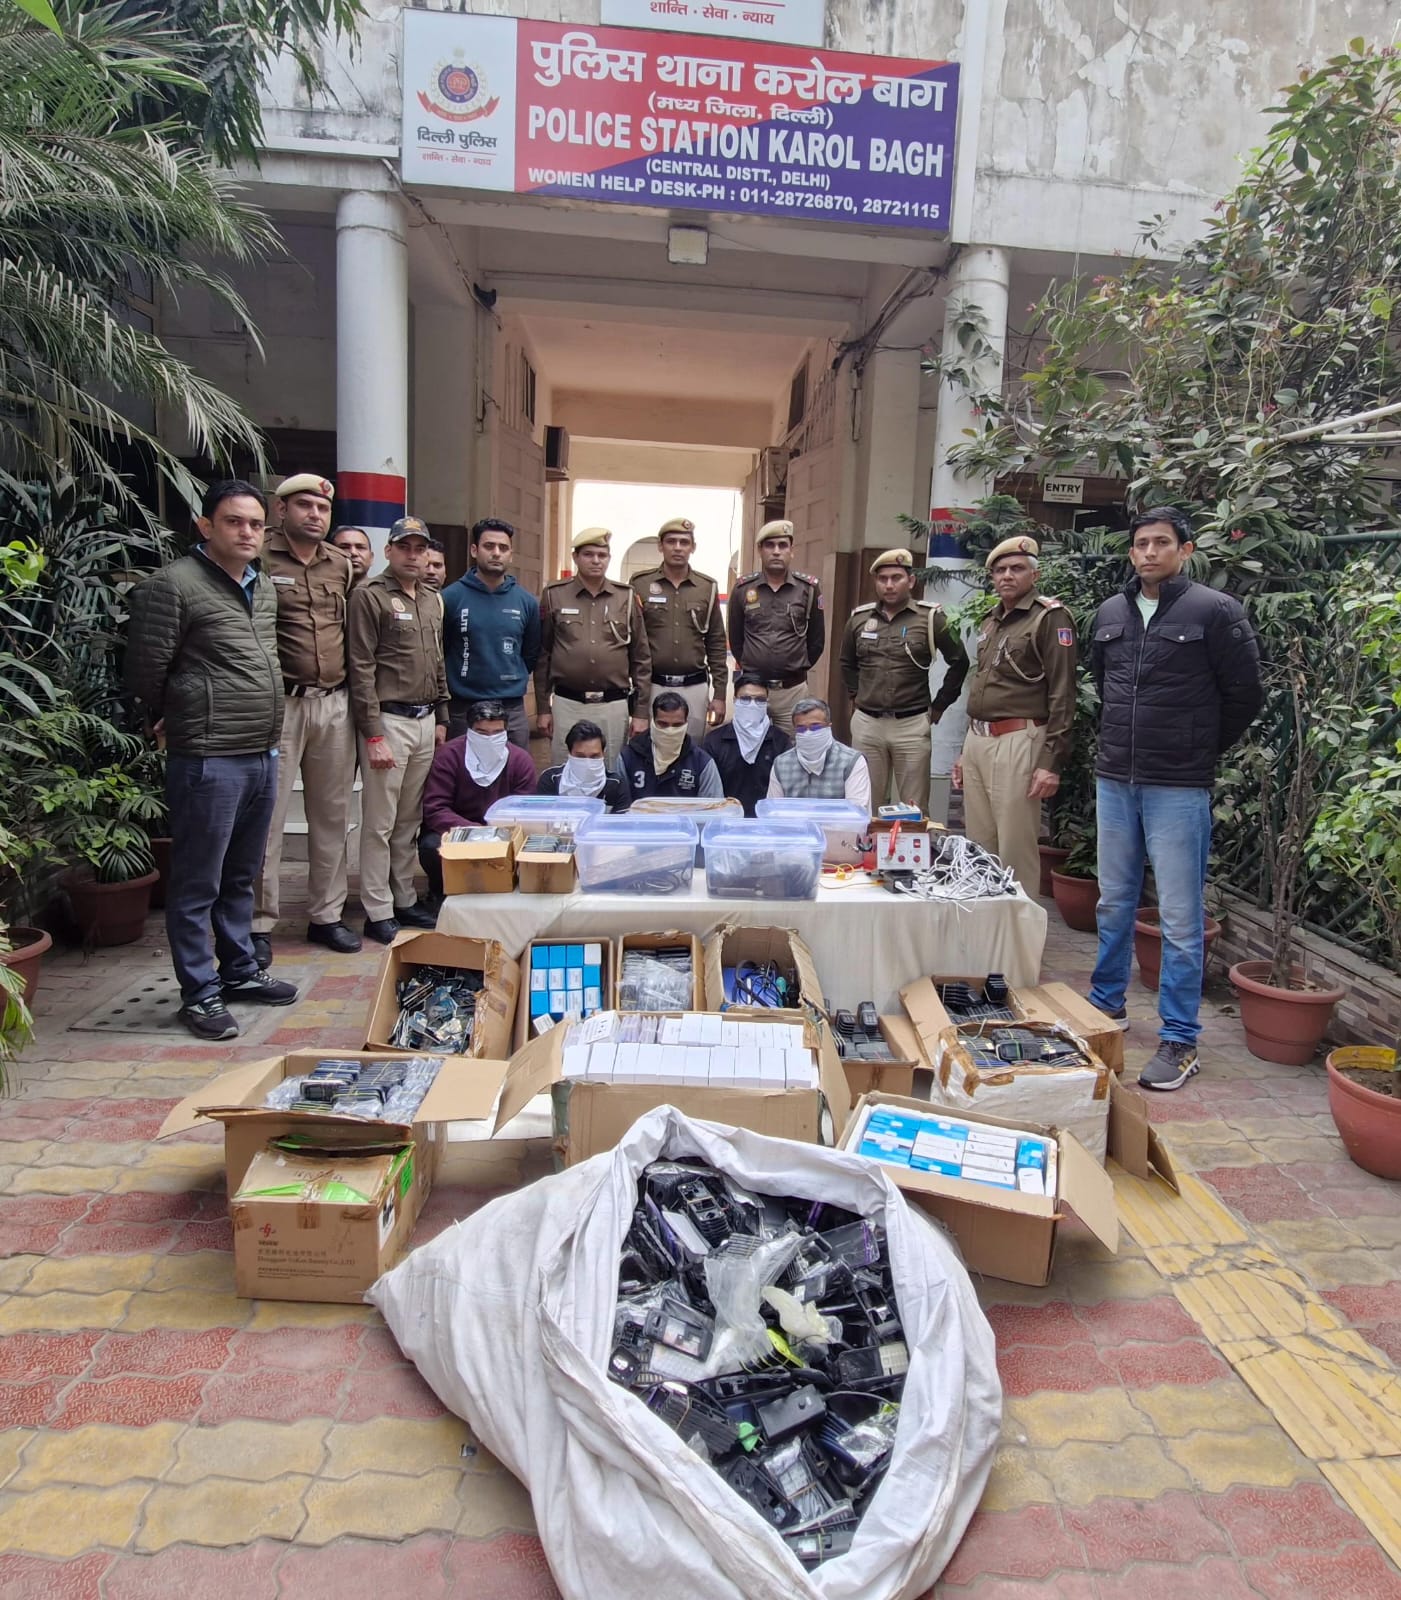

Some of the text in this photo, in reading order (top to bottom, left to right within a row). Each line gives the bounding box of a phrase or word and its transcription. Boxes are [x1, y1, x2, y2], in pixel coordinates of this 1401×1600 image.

[650, 0, 775, 25] शान्ति सेवा न्याय
[530, 31, 948, 112] पुलिस थाना करोल बाग
[648, 91, 834, 130] (मध्य जिला, दिल्ली)
[417, 126, 498, 149] दिल्ली पुलिस
[528, 105, 944, 178] POLICE STATION KAROL BAGH
[646, 158, 831, 190] (CENTRAL DISTT., DELHI)
[528, 167, 595, 188] WOMEN
[601, 175, 646, 193] HELP
[651, 180, 725, 200] DESK-PH
[740, 187, 858, 215] 011-28726870,
[862, 198, 940, 219] 28721115
[1045, 483, 1081, 493] ENTRY
[460, 608, 469, 633] ELITE
[634, 770, 646, 789] 3
